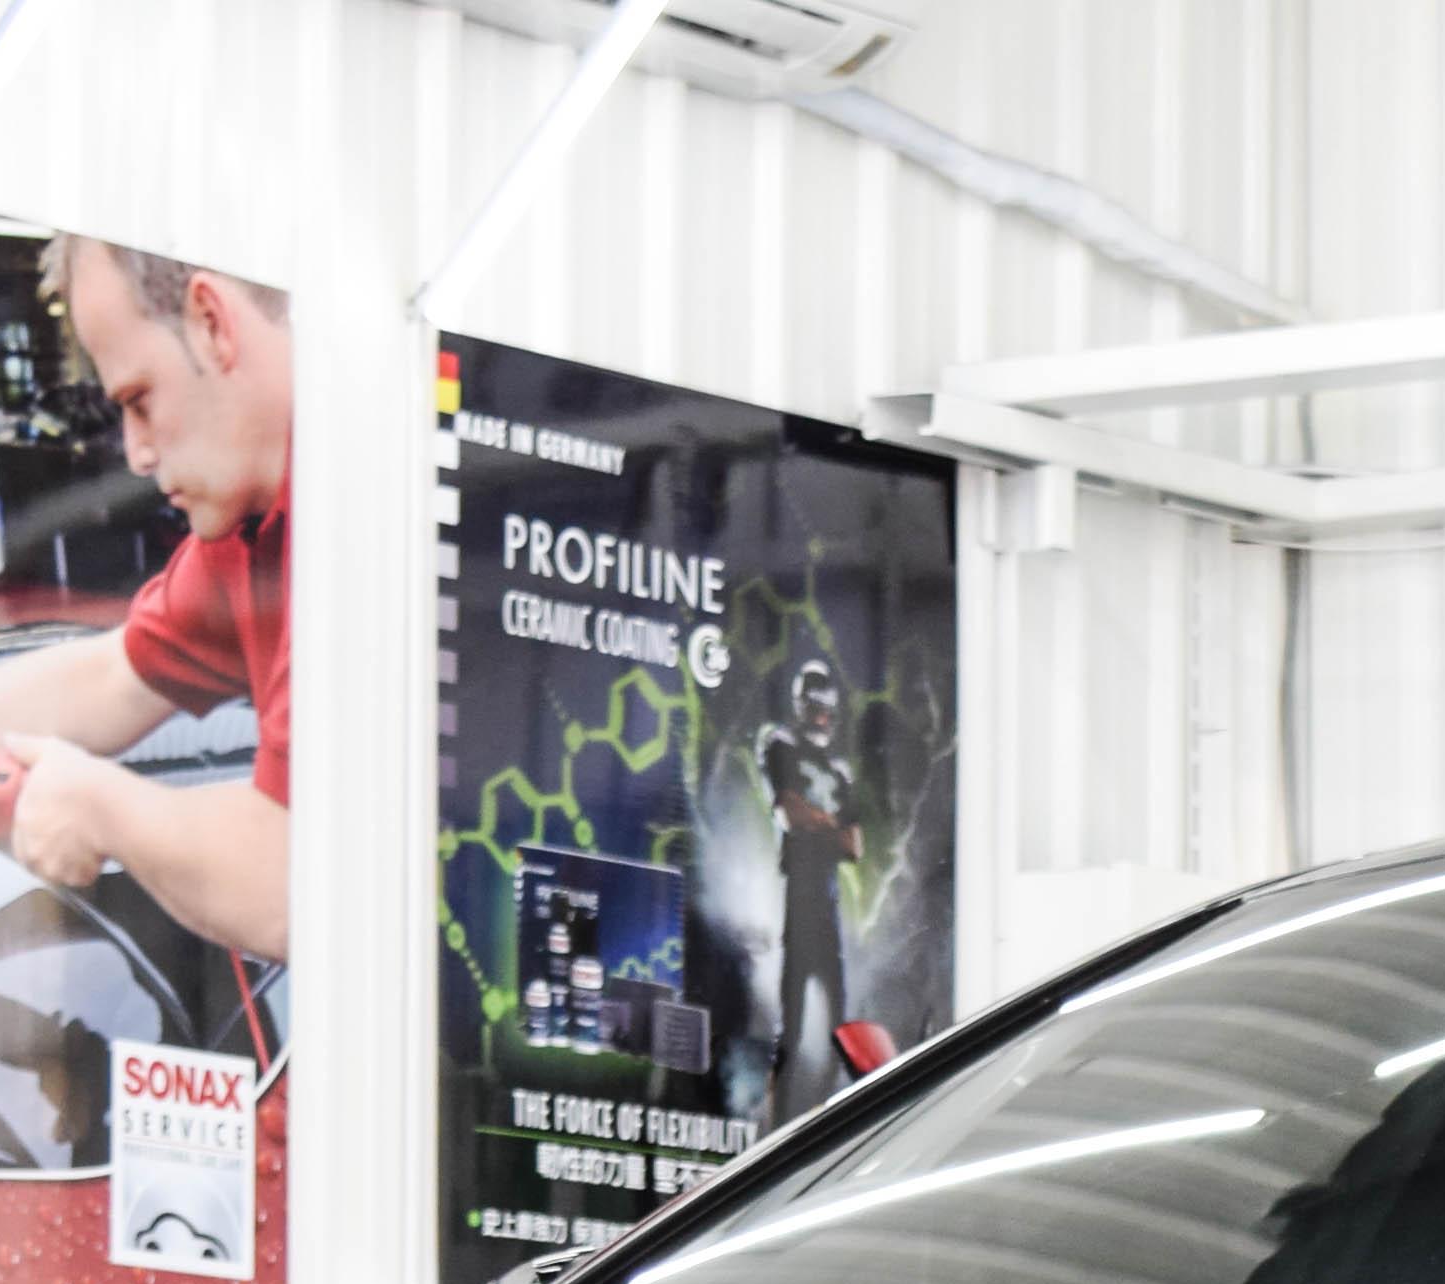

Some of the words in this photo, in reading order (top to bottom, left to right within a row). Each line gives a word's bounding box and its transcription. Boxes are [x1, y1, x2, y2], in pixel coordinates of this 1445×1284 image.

[455, 410, 508, 450] MADE
[509, 422, 535, 456] IN
[536, 428, 627, 476] GERMANY
[503, 513, 726, 615] PROFILINE
[502, 590, 593, 651] CERAMIC
[595, 608, 681, 668] COATING
[123, 1056, 244, 1112] SONAX
[123, 1109, 244, 1150] SERVICE
[512, 1088, 551, 1131] THE
[555, 1093, 615, 1139] FORCE
[616, 1101, 644, 1142] OF
[646, 1106, 759, 1156] FLEXIBILITY
